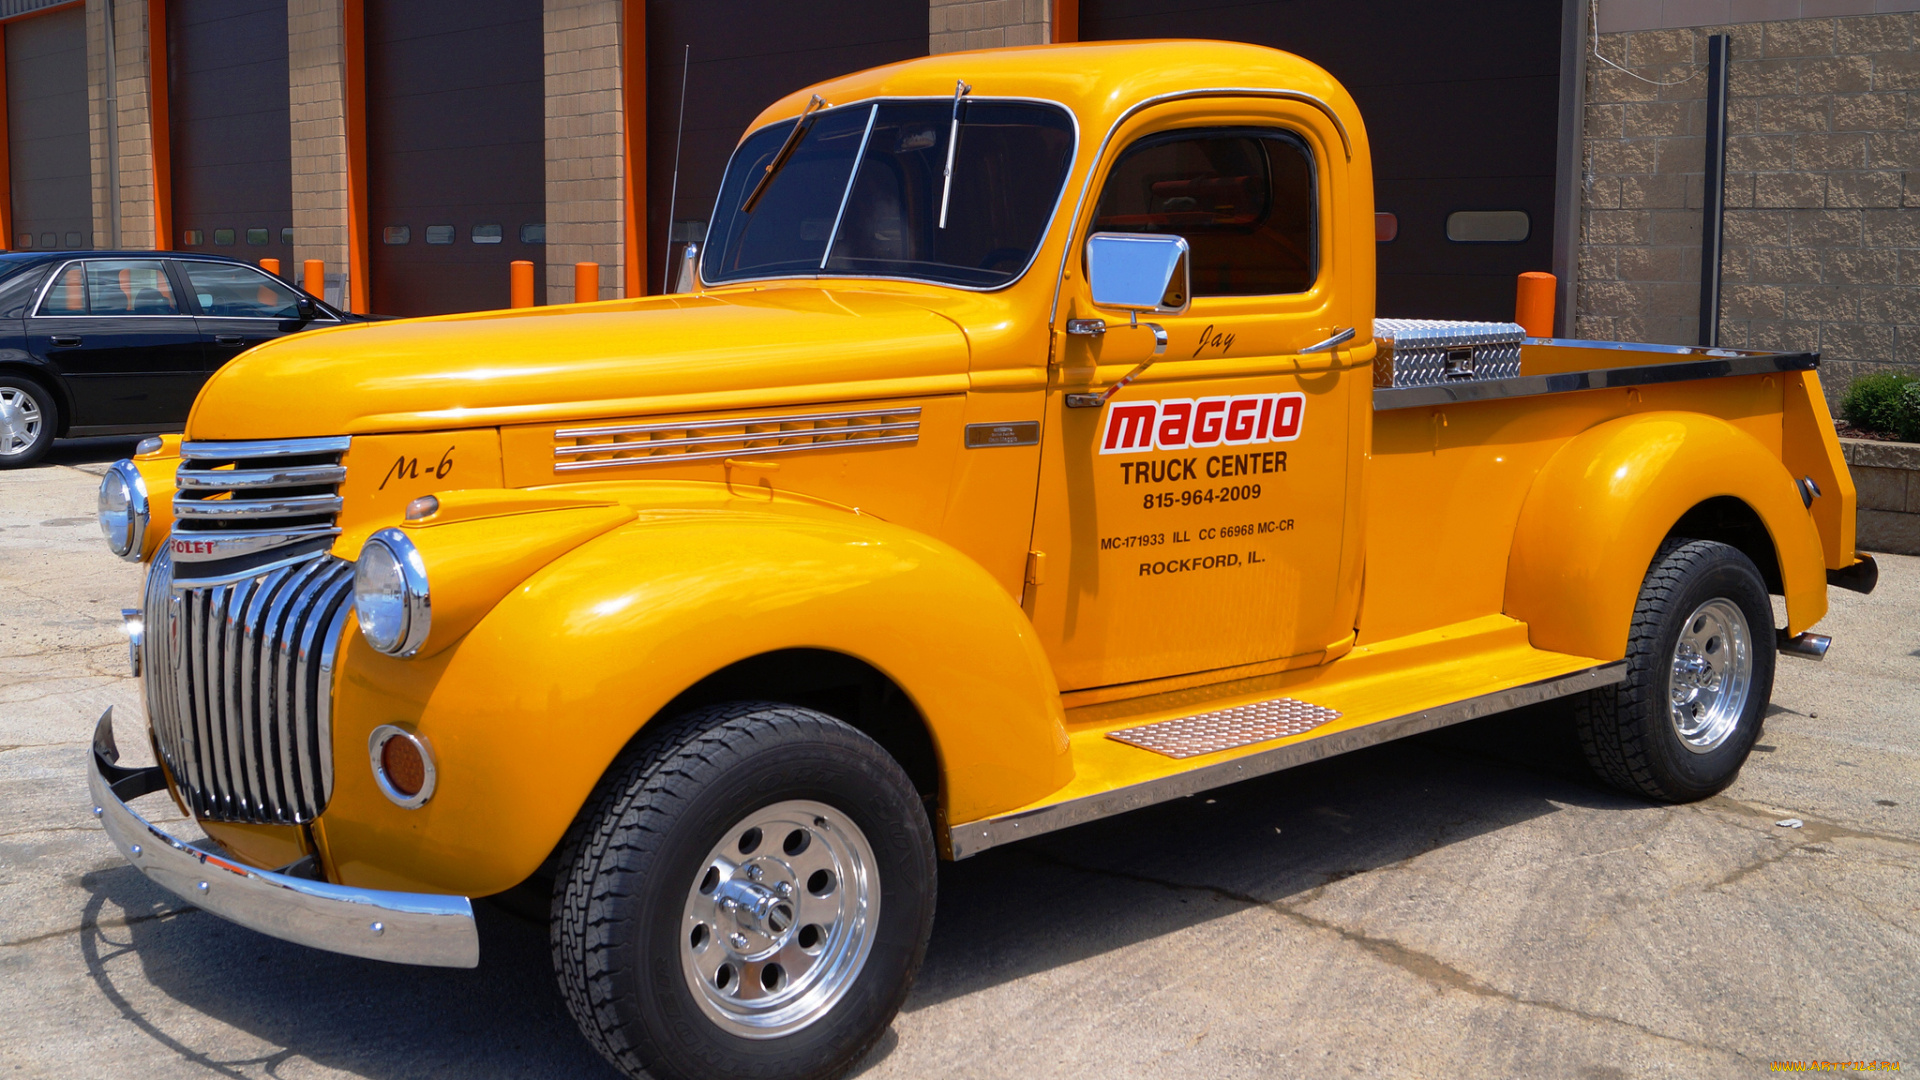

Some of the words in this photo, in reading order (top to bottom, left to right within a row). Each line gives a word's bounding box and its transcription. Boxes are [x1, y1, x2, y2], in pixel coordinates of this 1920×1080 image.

[1192, 324, 1236, 359] Jay
[1103, 396, 1304, 450] MAGGIO
[378, 444, 456, 491] M-6
[1120, 457, 1198, 485] TRUCK
[1206, 451, 1288, 478] CENTER
[1142, 484, 1262, 510] 815-964-2009
[1100, 533, 1166, 551] MC-171933
[1172, 530, 1191, 544] ILL
[1198, 528, 1216, 541] CC
[1220, 524, 1254, 539] 66968
[1257, 519, 1295, 535] MC-CR
[1139, 553, 1242, 577] ROCKFORD,
[1247, 551, 1266, 565] IL.
